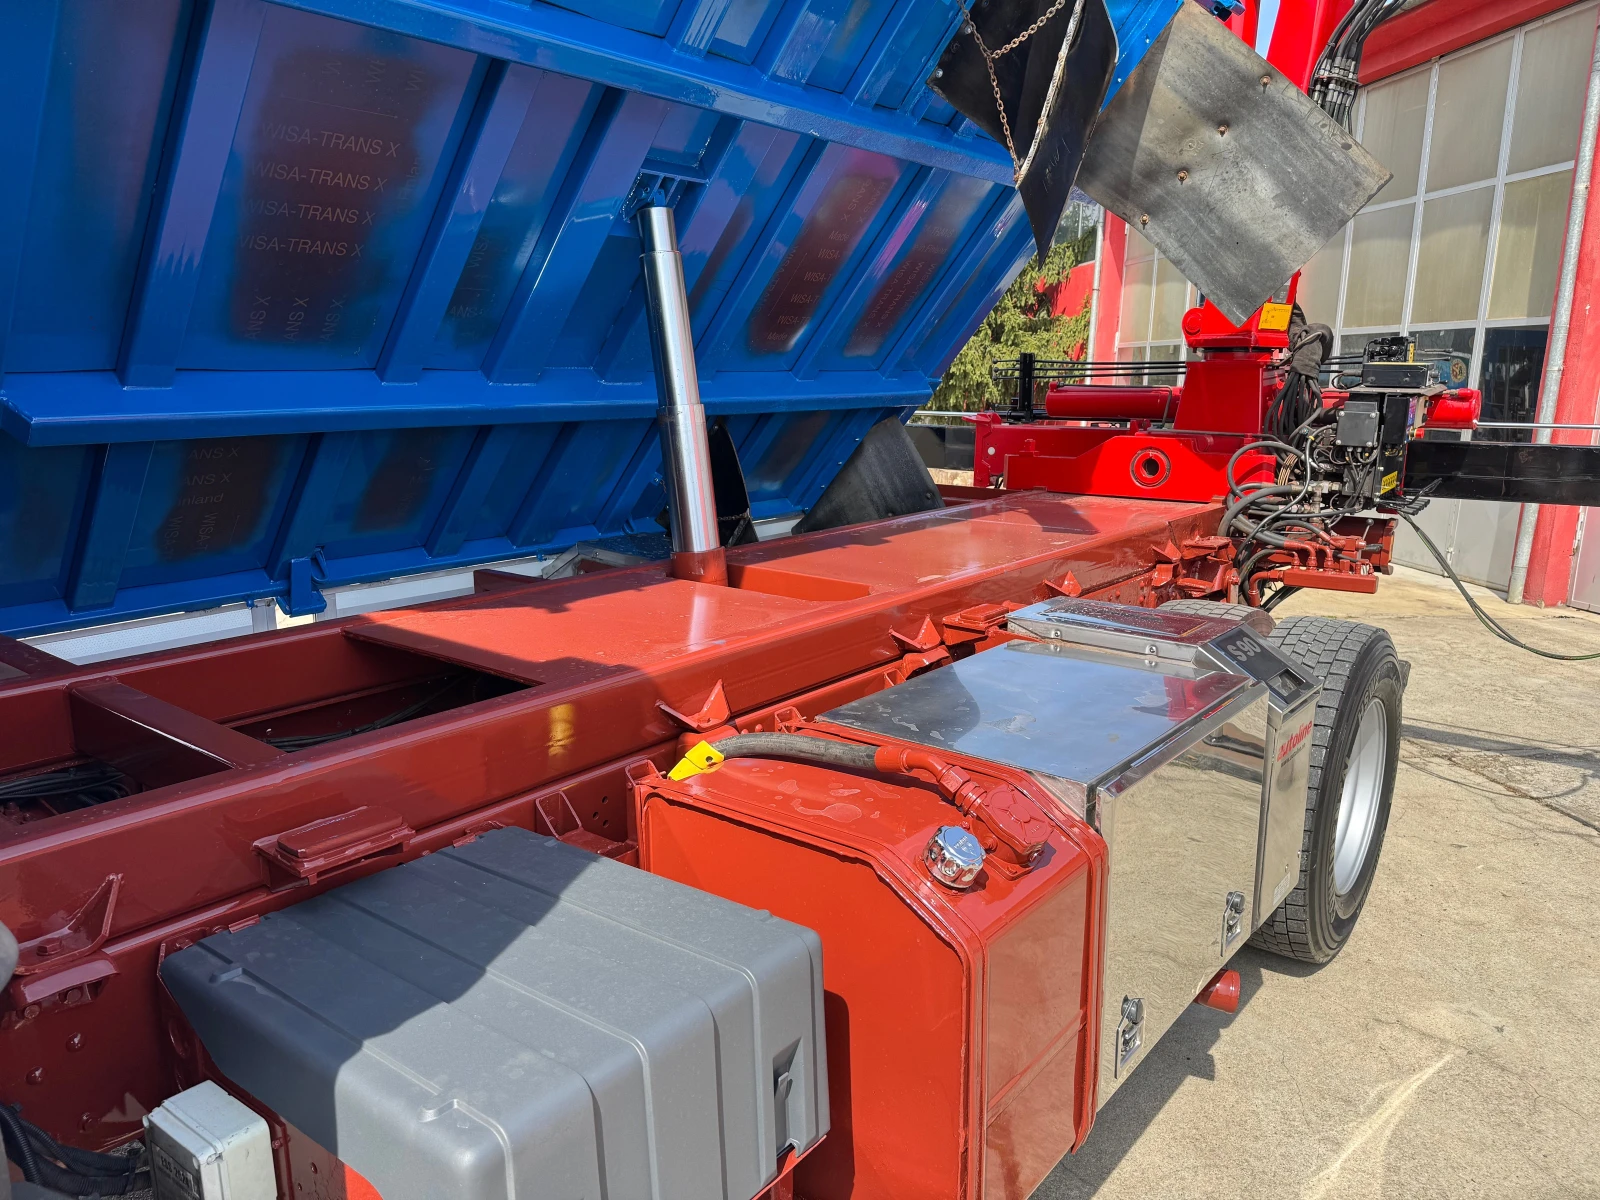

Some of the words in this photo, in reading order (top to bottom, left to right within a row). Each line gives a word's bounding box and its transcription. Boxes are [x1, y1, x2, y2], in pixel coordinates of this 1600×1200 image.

[261, 122, 383, 154] WISA-TRANS
[385, 141, 402, 158] X
[251, 161, 371, 190] WISA-TRANS
[373, 177, 389, 193] X
[362, 211, 376, 226] X
[350, 243, 364, 258] X
[227, 446, 241, 458] X
[220, 471, 233, 484] X
